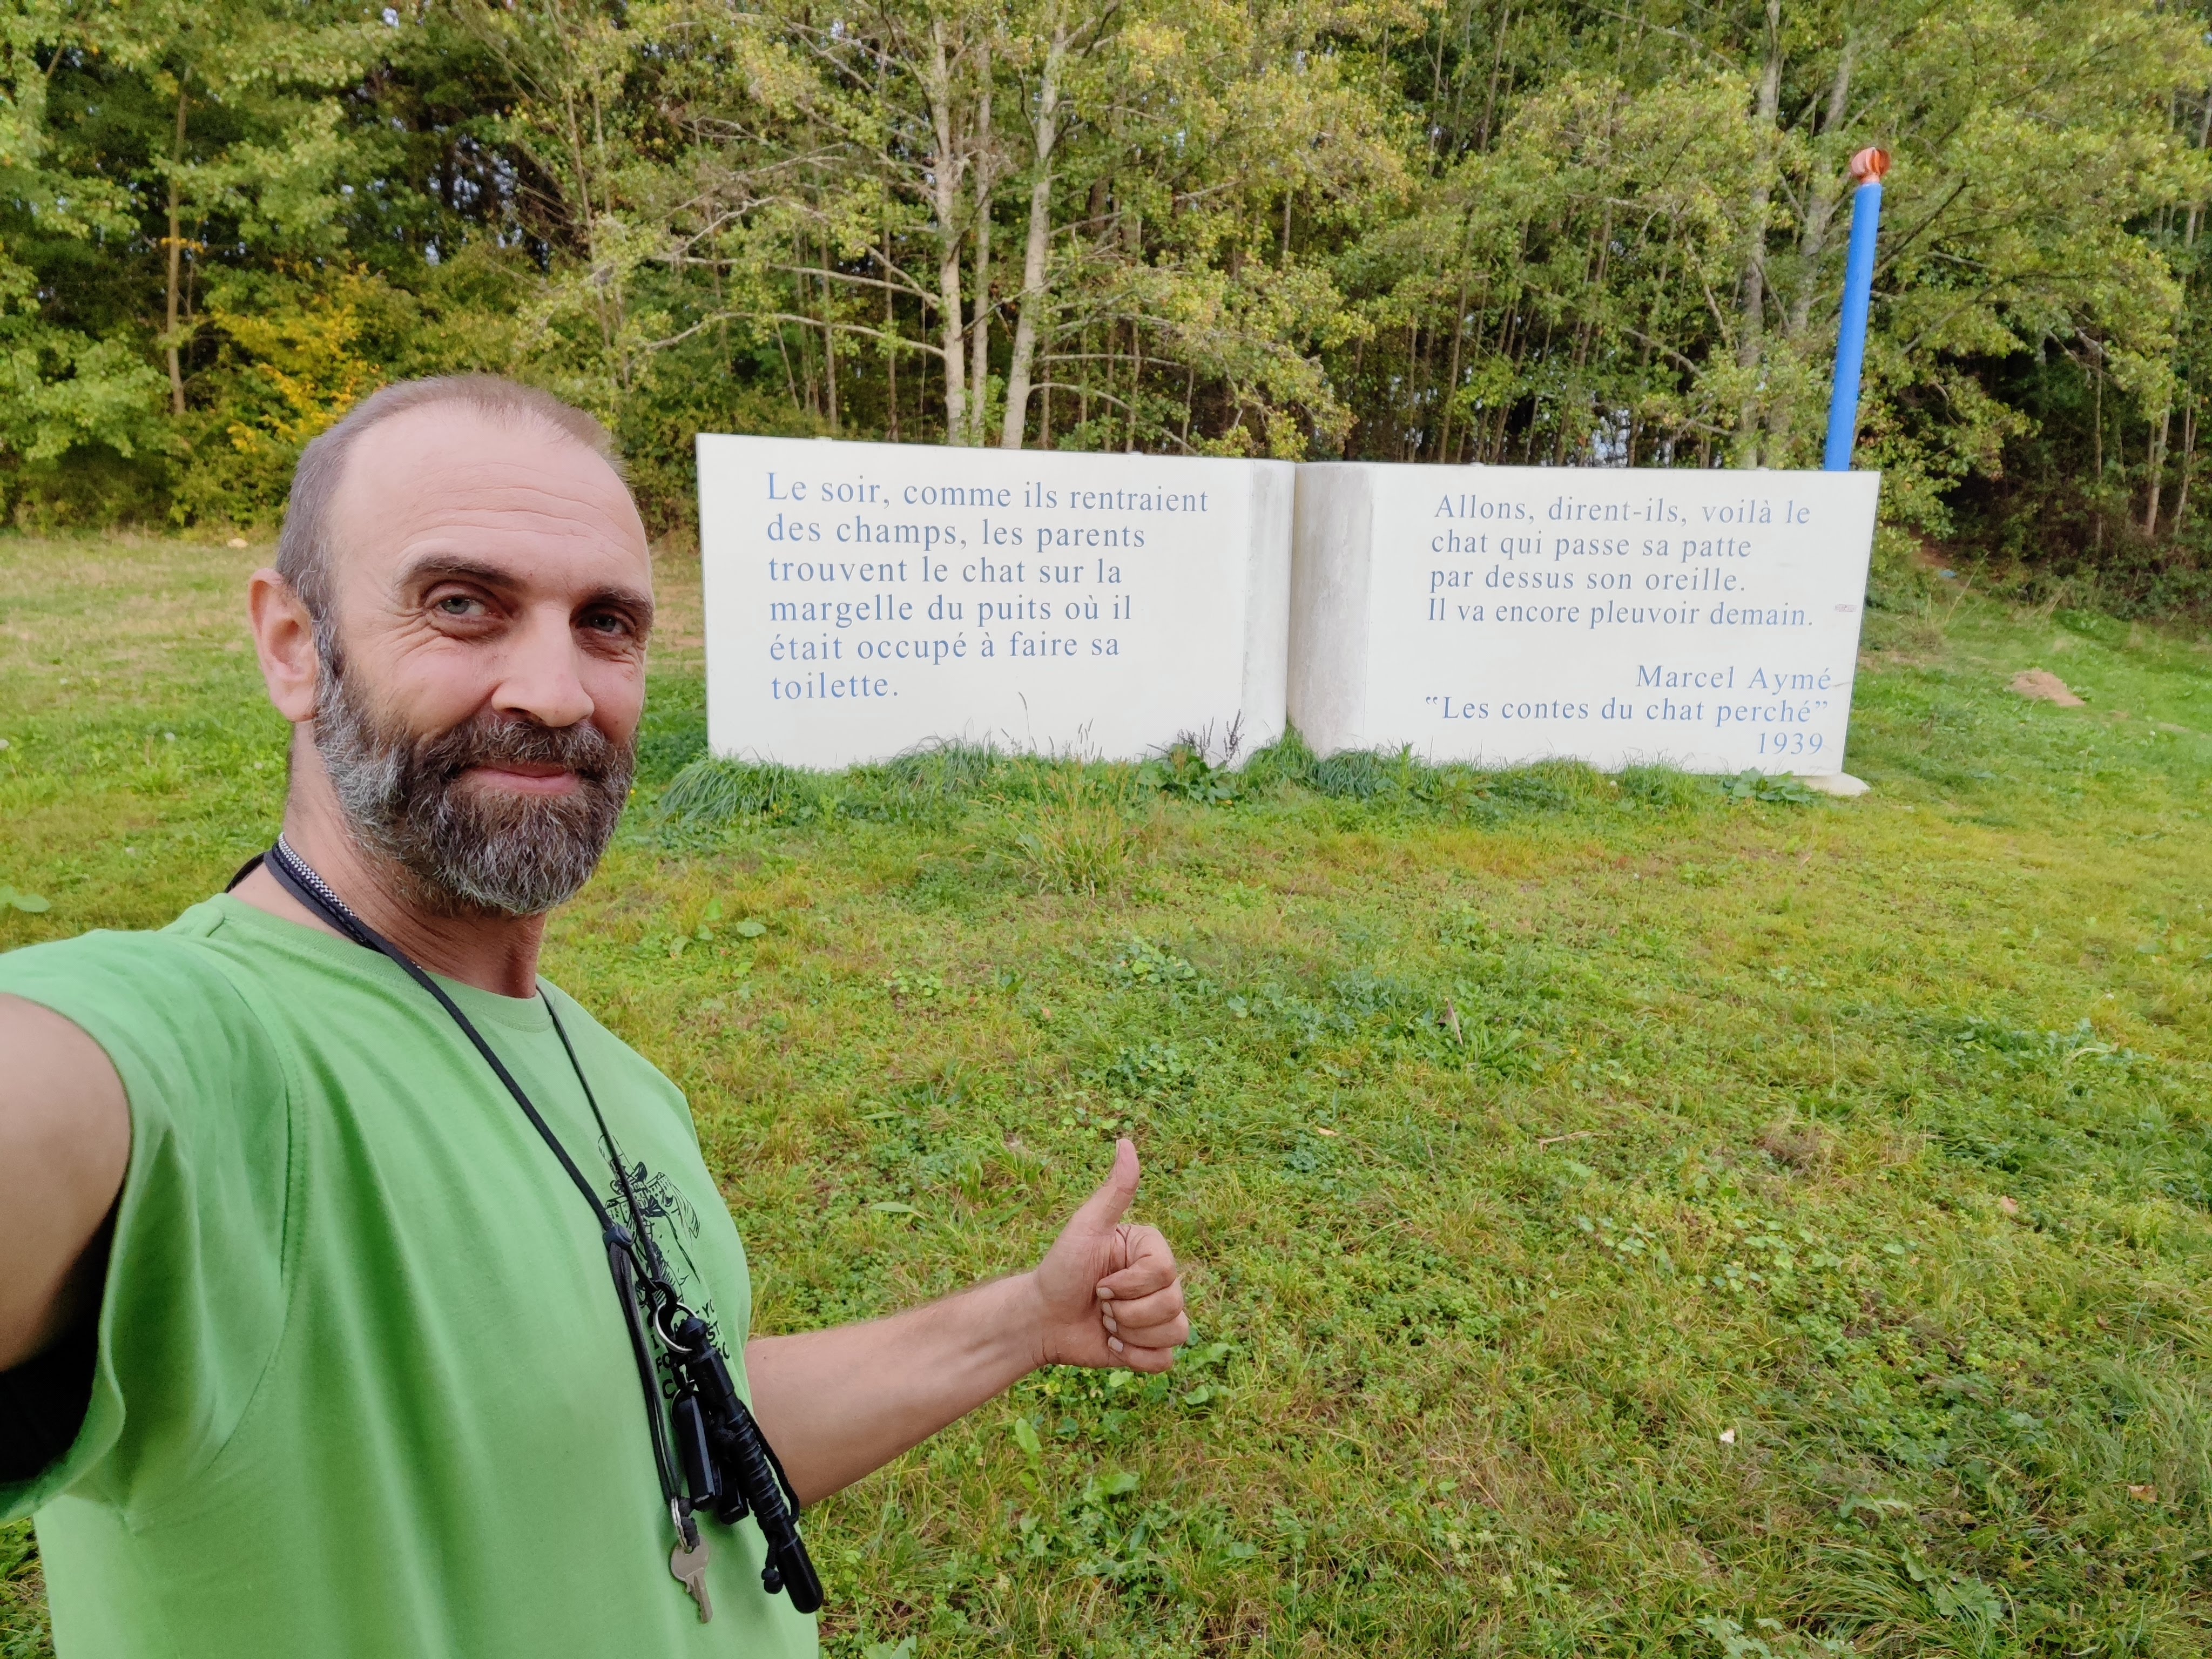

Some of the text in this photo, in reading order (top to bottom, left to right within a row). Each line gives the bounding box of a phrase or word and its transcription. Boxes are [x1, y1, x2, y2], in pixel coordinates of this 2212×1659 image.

[767, 472, 1208, 512] Le soir, comme ils rentraient
[1434, 494, 1810, 526] Allons, dirent-ils, voilà le
[767, 512, 1144, 554] des champs, les parents
[1432, 529, 1751, 564] chat qui passe sa patte
[768, 555, 1122, 584] trouvent le chat sur la
[1429, 564, 1745, 594] par dessus son oreille.
[770, 594, 1131, 629] margelle du puits où il
[1428, 597, 1812, 630] Il va encore pleuvoir demain.
[770, 631, 1120, 665] était occupé à faire sa
[771, 671, 898, 700] toilette.
[1636, 665, 1831, 696] Marcel Aymé
[1502, 699, 1588, 719] contes
[1601, 696, 1633, 720] du
[1647, 697, 1702, 720] chat
[1759, 732, 1823, 754] 1939
